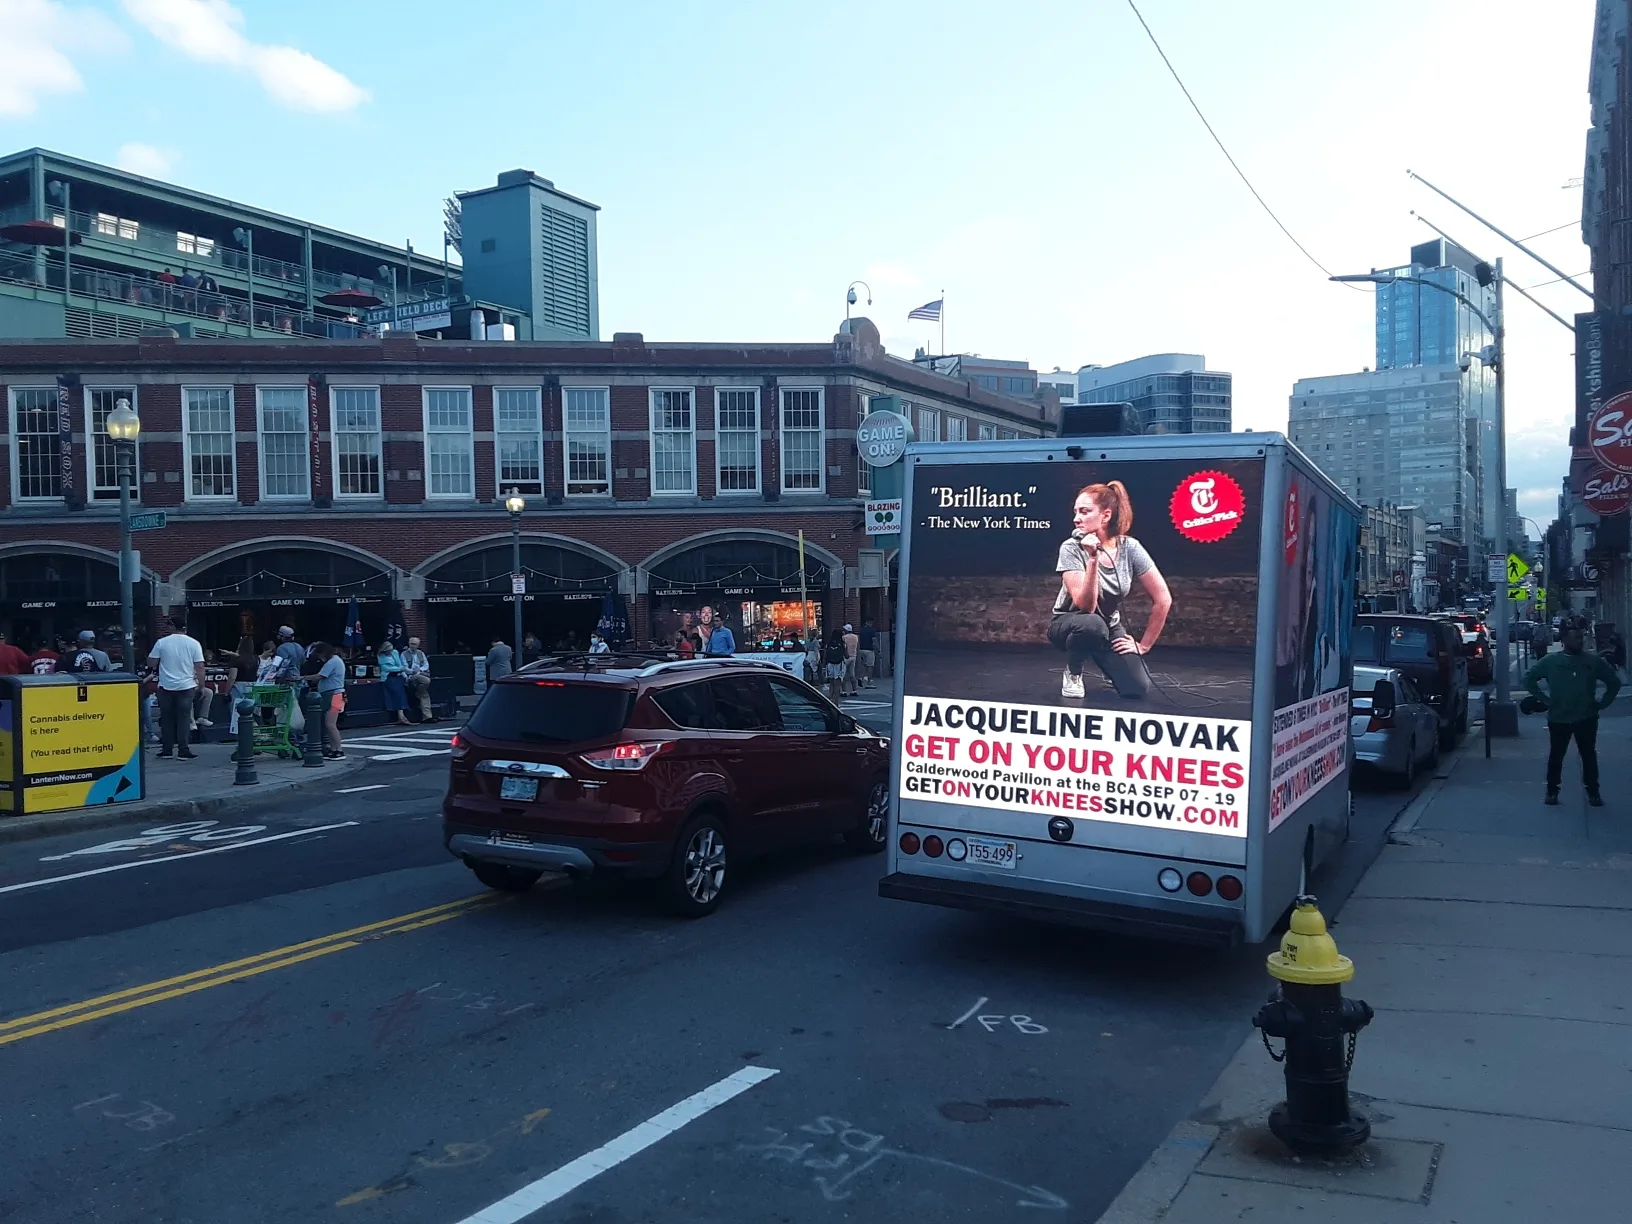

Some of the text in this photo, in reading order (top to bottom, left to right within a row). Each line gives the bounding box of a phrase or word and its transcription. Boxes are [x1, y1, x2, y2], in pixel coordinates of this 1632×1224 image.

[367, 311, 390, 322] LEFT
[396, 305, 420, 317] IELD
[423, 300, 448, 312] DECK
[60, 386, 73, 489] RED SOX
[859, 425, 904, 442] GAME
[868, 442, 895, 457] ON!
[1584, 474, 1630, 500] Sal's
[931, 486, 1037, 508] "Brilliant."
[867, 502, 900, 512] BLAZING
[928, 516, 951, 529] The
[953, 516, 980, 529] New
[983, 516, 1011, 529] York
[1014, 516, 1051, 529] Times
[22, 601, 43, 609] GAME
[30, 712, 105, 724] Cannabis delivery
[30, 727, 60, 736] is here
[910, 702, 1240, 752] JACQUELINE NOVAK
[30, 743, 114, 759] (You read that right)
[905, 734, 960, 761] GET
[968, 739, 1013, 767] ON
[1022, 743, 1114, 776] YOUR
[1126, 752, 1244, 789] KNEES
[30, 772, 93, 785] LanternNow.com
[906, 761, 989, 780] Calderwood
[993, 769, 1052, 787] Pavilion
[1056, 777, 1071, 790] at
[1076, 778, 1101, 792] the
[1106, 781, 1138, 796] BCA
[1142, 784, 1174, 799] SEP
[1179, 788, 1199, 802] 07
[1215, 792, 1236, 806] 19
[905, 777, 1239, 828] GETONYOURKNEESSHOW.COM
